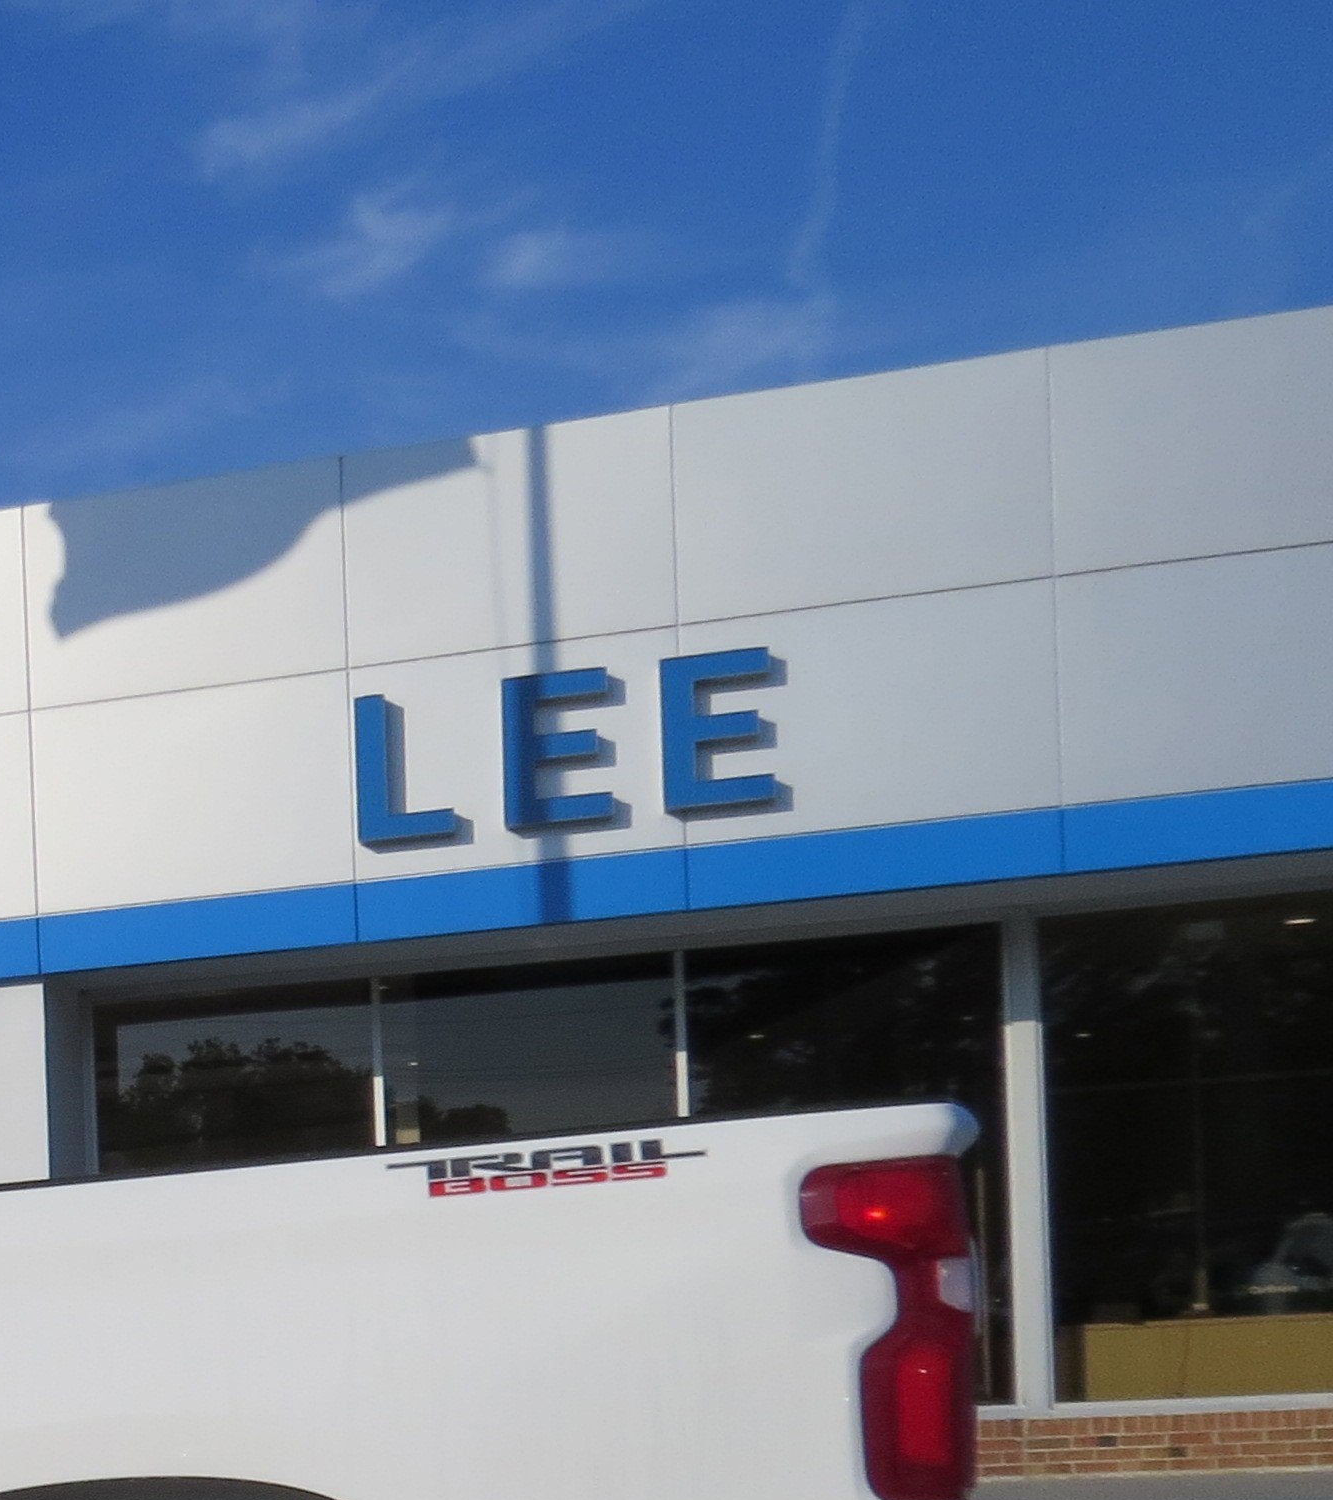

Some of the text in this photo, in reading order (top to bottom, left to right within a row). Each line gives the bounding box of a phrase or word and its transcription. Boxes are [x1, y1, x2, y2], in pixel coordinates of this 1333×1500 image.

[354, 646, 777, 842] LEE
[386, 1139, 707, 1181] TRAIL
[428, 1160, 668, 1198] BOSS
